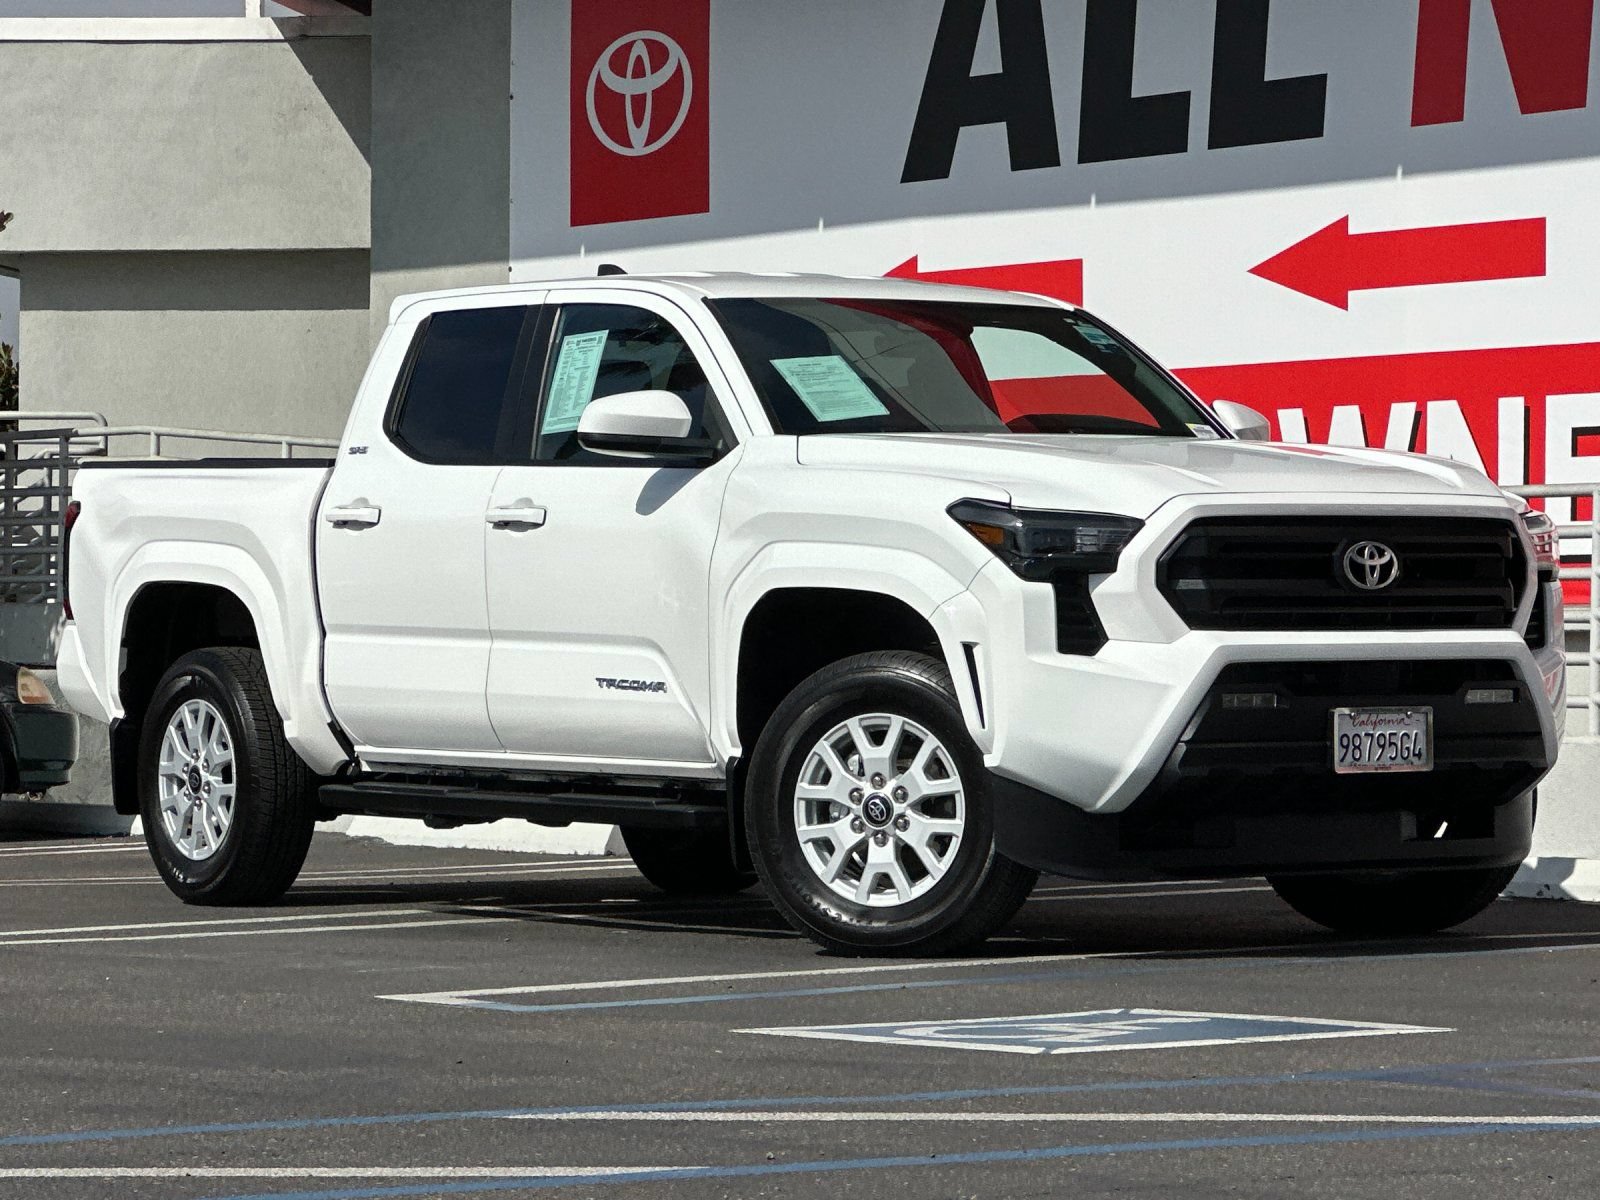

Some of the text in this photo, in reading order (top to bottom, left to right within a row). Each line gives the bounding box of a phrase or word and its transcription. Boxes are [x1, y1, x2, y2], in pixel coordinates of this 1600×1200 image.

[900, 0, 1328, 184] ALL
[595, 677, 667, 693] TACOMA
[1352, 713, 1411, 730] California
[1340, 731, 1422, 762] 98795G4
